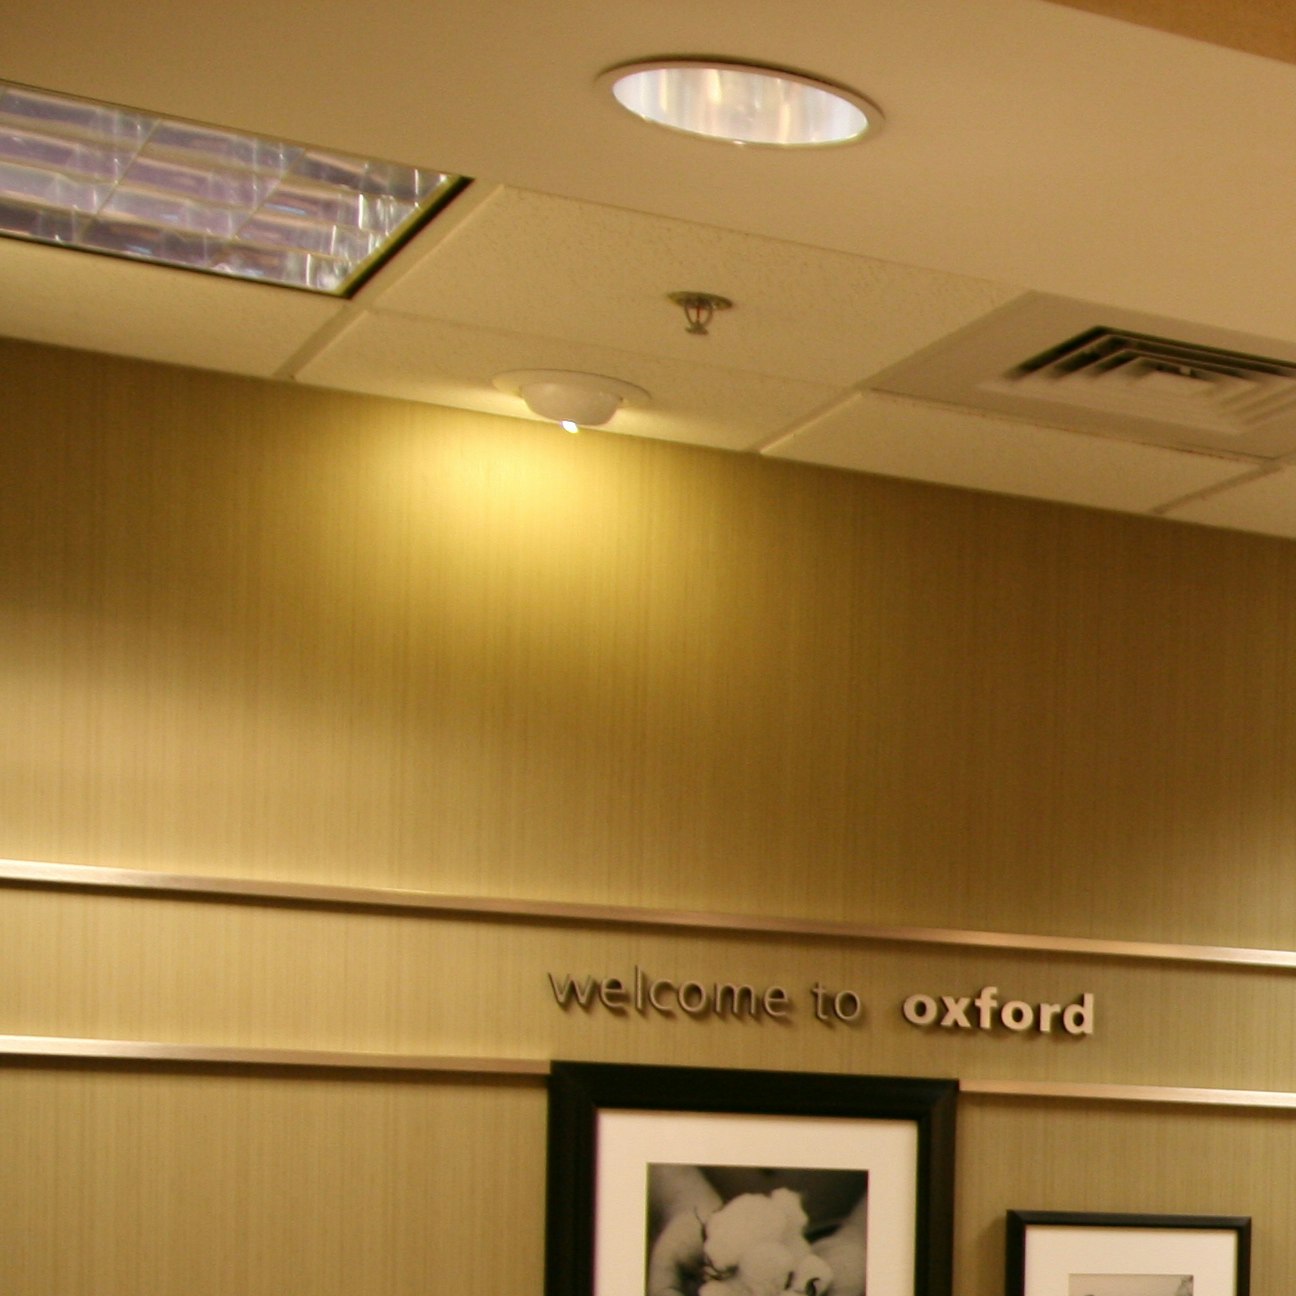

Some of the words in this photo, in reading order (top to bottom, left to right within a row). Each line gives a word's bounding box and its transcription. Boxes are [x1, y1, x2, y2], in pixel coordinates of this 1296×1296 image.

[549, 965, 790, 1017] welcome
[812, 983, 861, 1021] to
[903, 986, 1095, 1035] oxford
